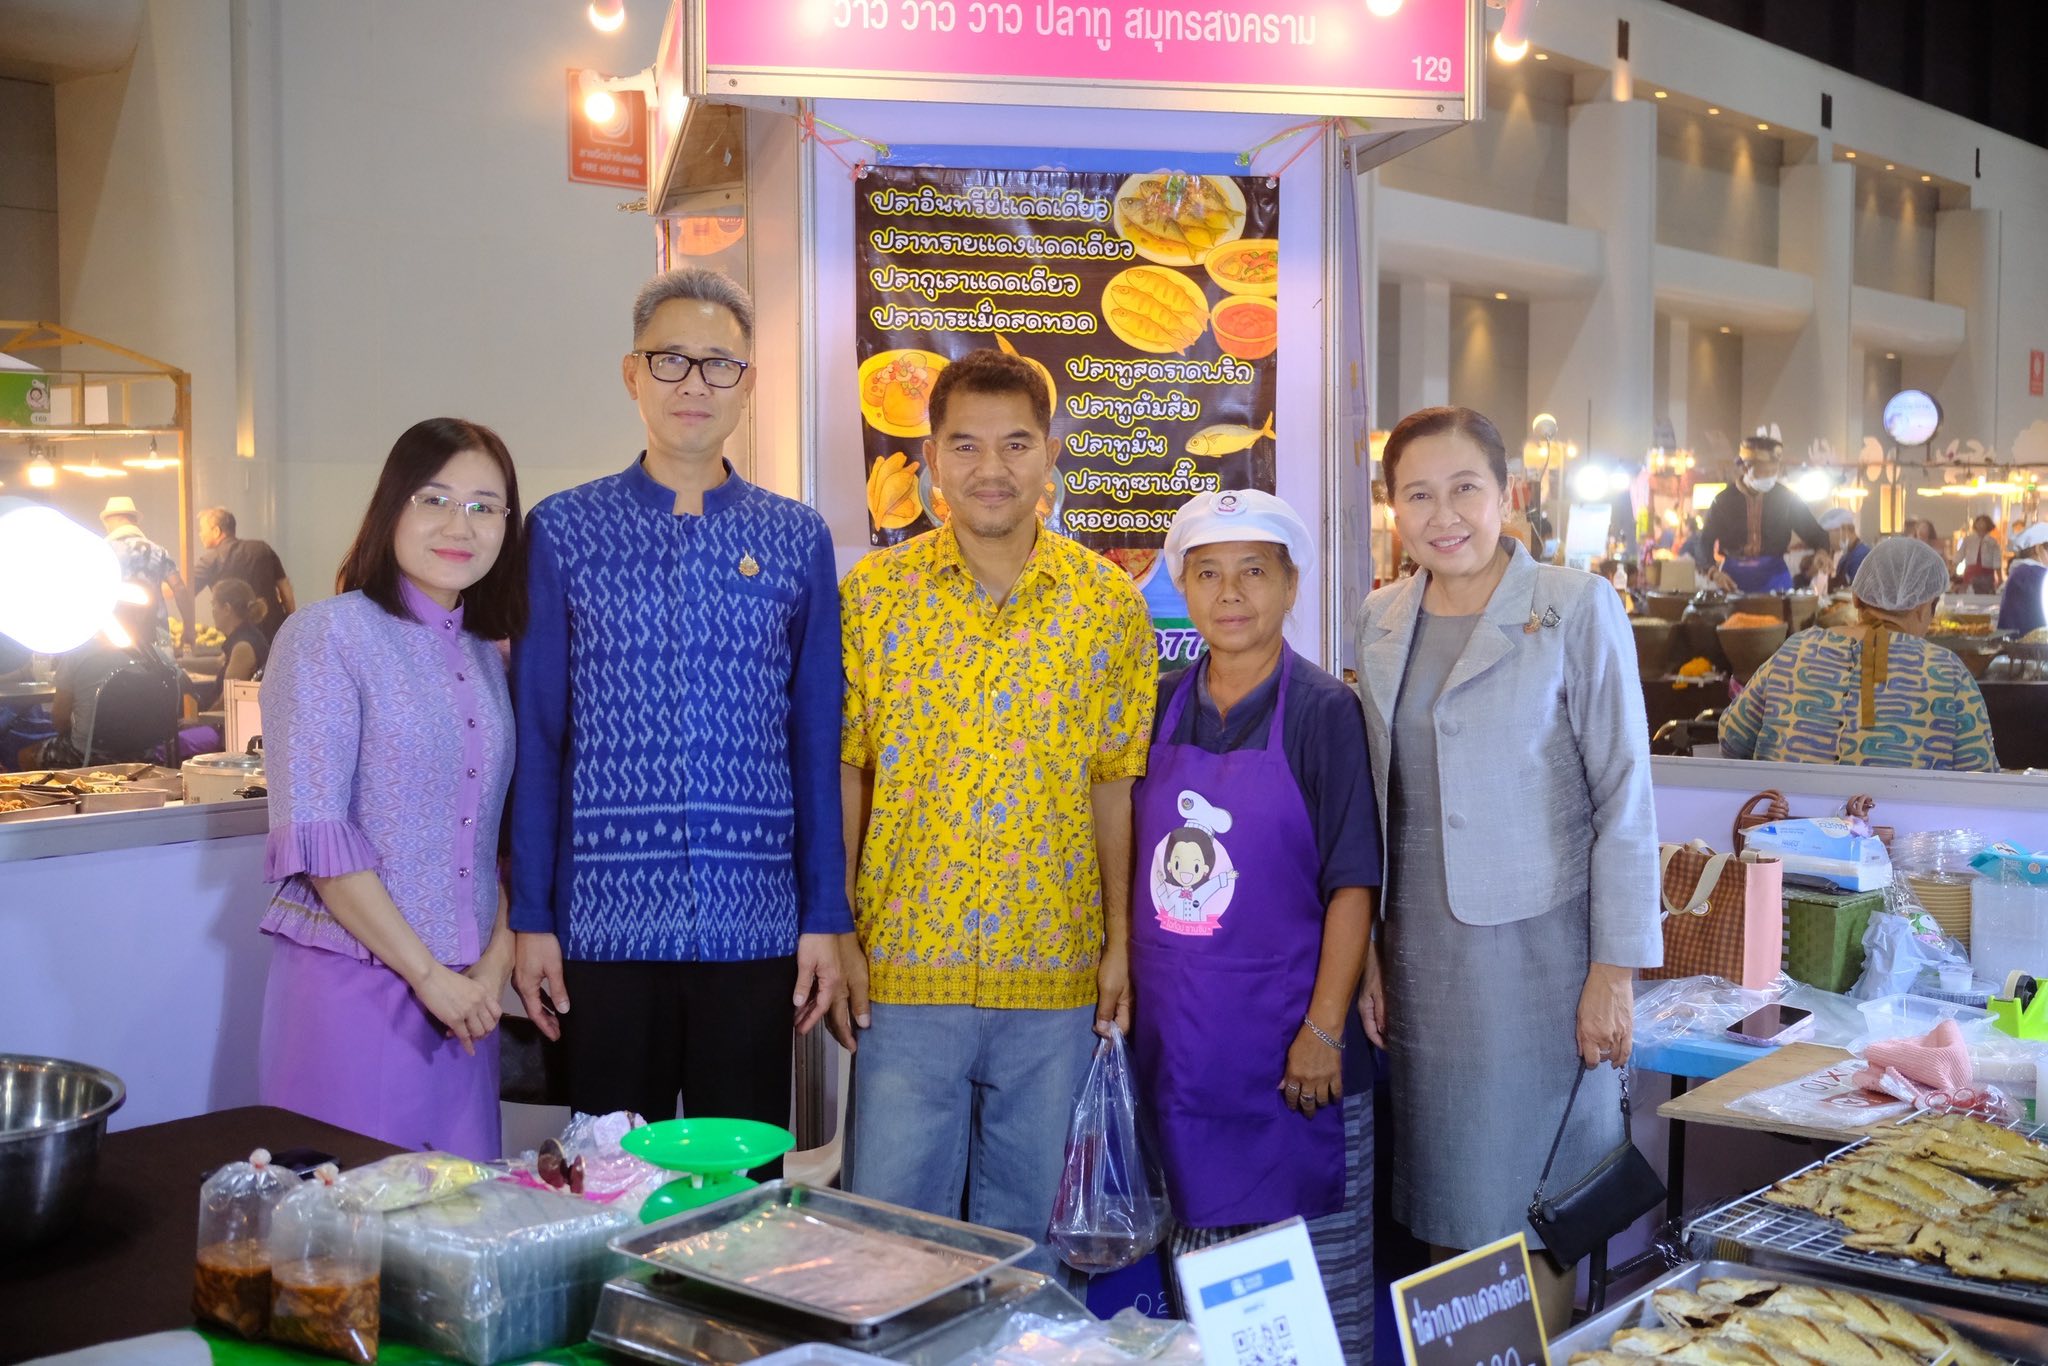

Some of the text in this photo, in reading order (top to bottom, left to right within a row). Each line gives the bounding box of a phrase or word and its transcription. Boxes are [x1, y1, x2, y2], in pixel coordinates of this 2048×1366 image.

[901, 0, 956, 32] วาว
[968, 1, 1023, 34] วาว
[1035, 0, 1112, 52] ปลาทู
[1124, 6, 1317, 53] สมุทรสงคราม
[1411, 56, 1452, 83] 129
[872, 187, 1110, 220] ปลาอินทรีย์แดดเดียว
[872, 228, 1135, 258] ปลาทรายแดงแดดเดียว
[872, 266, 1078, 299] ปลากุเลาแดดเดียว
[872, 299, 1095, 332] ปลาจาระเม็ดสดทอด
[1068, 357, 1252, 388] ปลาทูสดราดพริก
[1068, 391, 1198, 426] ปลาทูต้มส้ม
[1068, 429, 1166, 464] ปลาทูมัน
[1066, 460, 1218, 500] ปลาทูซาเตี๊ยะ
[1066, 510, 1176, 531] หอยดองแ
